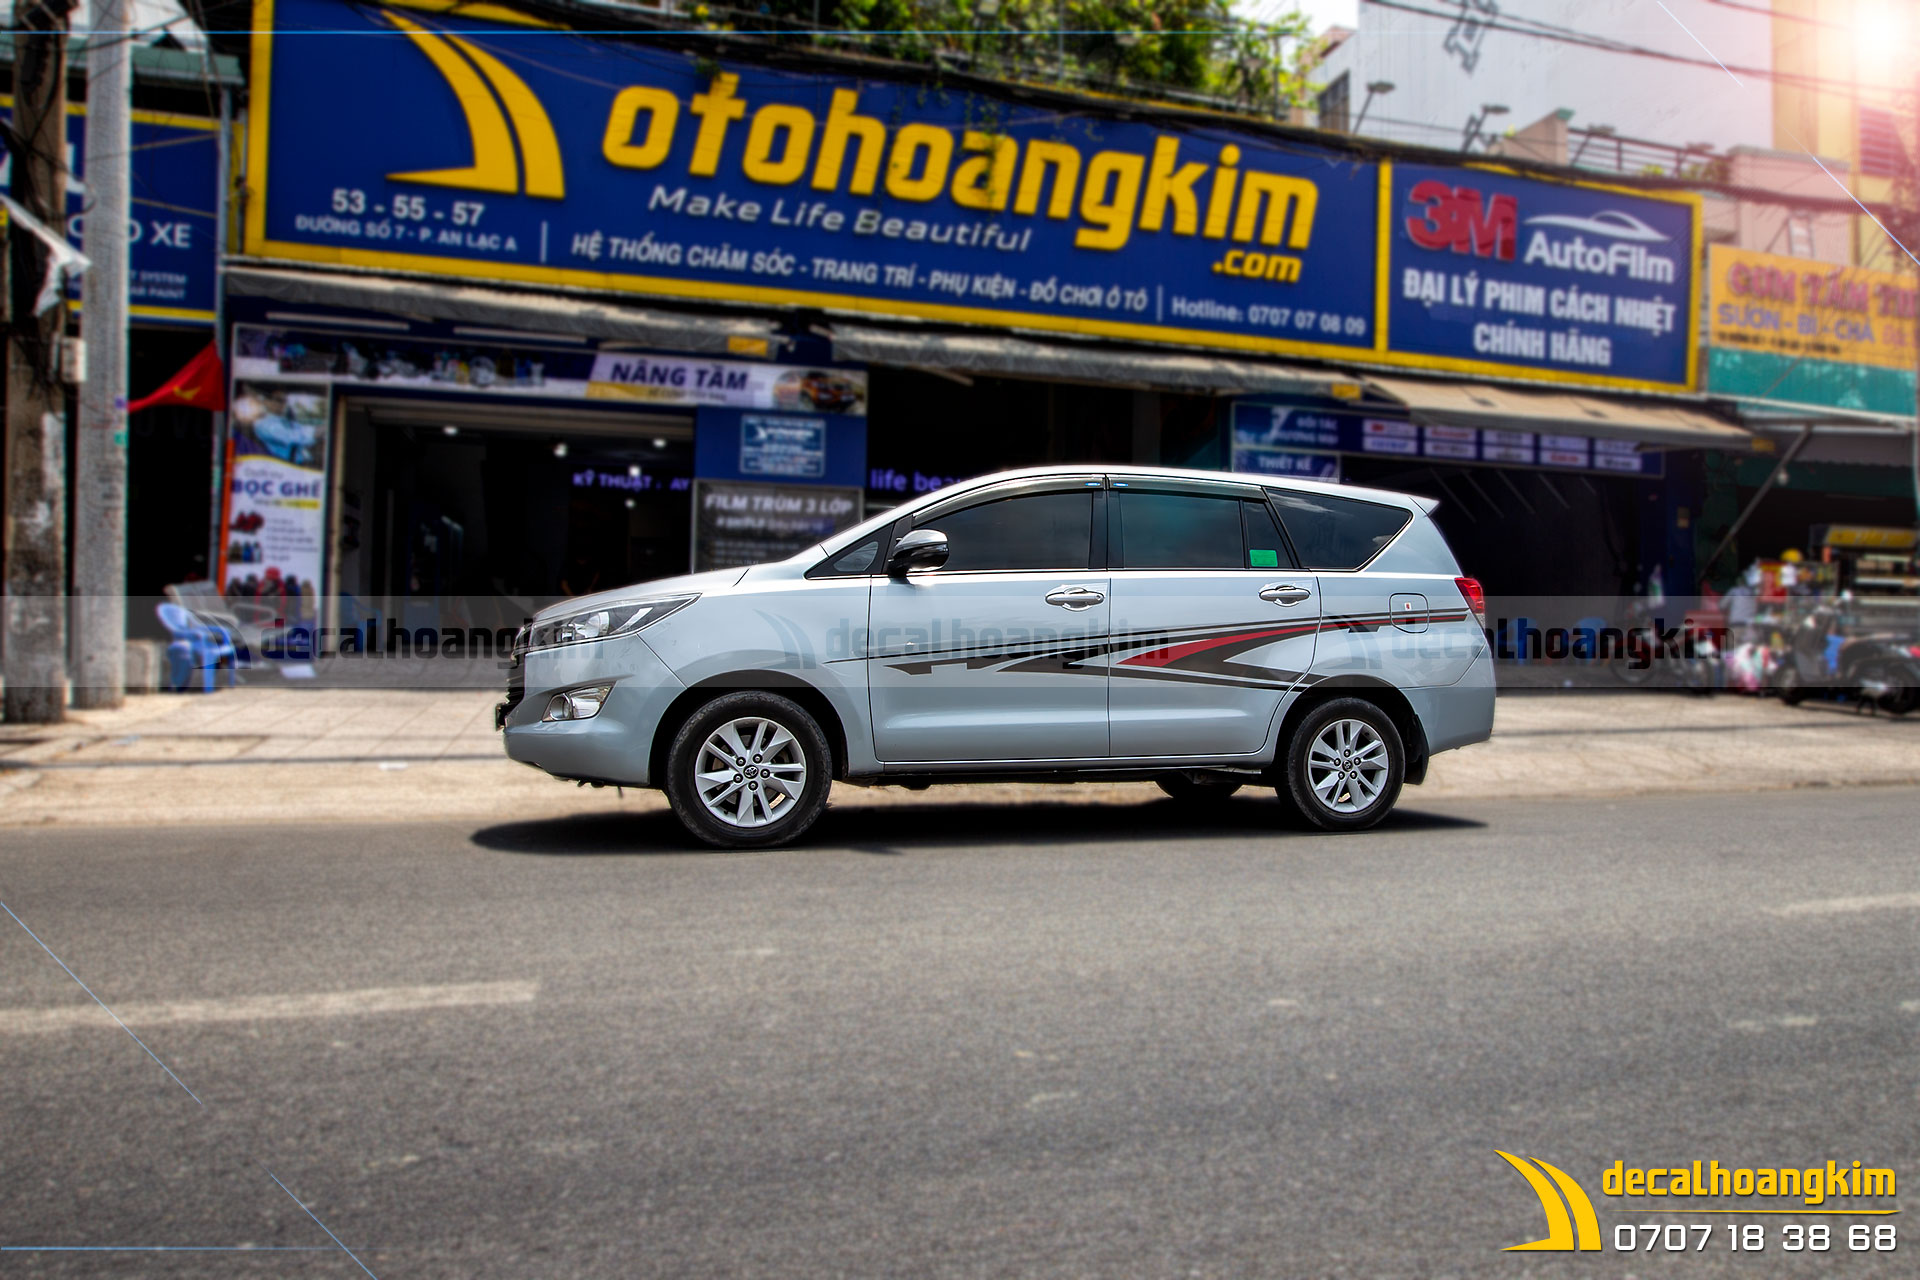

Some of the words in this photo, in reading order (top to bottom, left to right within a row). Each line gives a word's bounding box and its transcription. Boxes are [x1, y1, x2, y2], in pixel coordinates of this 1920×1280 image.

[602, 72, 1319, 251] otohoangkim
[332, 188, 366, 214] 53
[392, 194, 426, 220] 55
[452, 201, 485, 226] 57
[648, 184, 762, 221] Make
[770, 198, 845, 230] Life
[853, 208, 1033, 250] Beautiful
[1405, 179, 1518, 262] 3M
[150, 221, 191, 248] XE
[365, 217, 391, 239] SỐ
[395, 224, 405, 239] 7
[438, 229, 463, 247] AN
[466, 232, 500, 252] LẠC
[505, 237, 518, 252] A
[570, 230, 604, 260] HỆ
[608, 230, 682, 265] THỐNG
[687, 242, 748, 271] CHĂM
[752, 246, 796, 275] SÓC
[812, 257, 879, 284] TRANG
[883, 263, 918, 288] TRÍ
[928, 270, 970, 297] PHỤ
[971, 273, 1017, 300] KIỆN
[1211, 249, 1303, 283] .com
[1523, 231, 1675, 284] AutoFilm
[1172, 297, 1243, 322] Hotline:
[1249, 305, 1291, 327] 0707
[1295, 311, 1315, 329] 07
[1345, 315, 1366, 336] 09
[1403, 267, 1446, 307] ĐẠI
[1451, 270, 1480, 308] LÝ
[1484, 279, 1546, 316] PHIM
[1550, 285, 1610, 324] CÁCH
[1614, 295, 1677, 337] NHIỆT
[1473, 319, 1545, 359] CHÍNH
[1550, 328, 1611, 366] HÃNG
[610, 359, 687, 386] NÂNG
[695, 362, 749, 391] TẦM
[573, 469, 596, 487] KỸ
[599, 471, 652, 493] THUẬT
[870, 468, 908, 491] life
[1295, 455, 1312, 471] KẾ
[230, 479, 274, 498] BỌC
[279, 479, 320, 498] GHẾ
[705, 493, 747, 510] FILM
[752, 493, 802, 513] TRÙM
[806, 498, 816, 513] 3
[820, 495, 854, 515] LỚP
